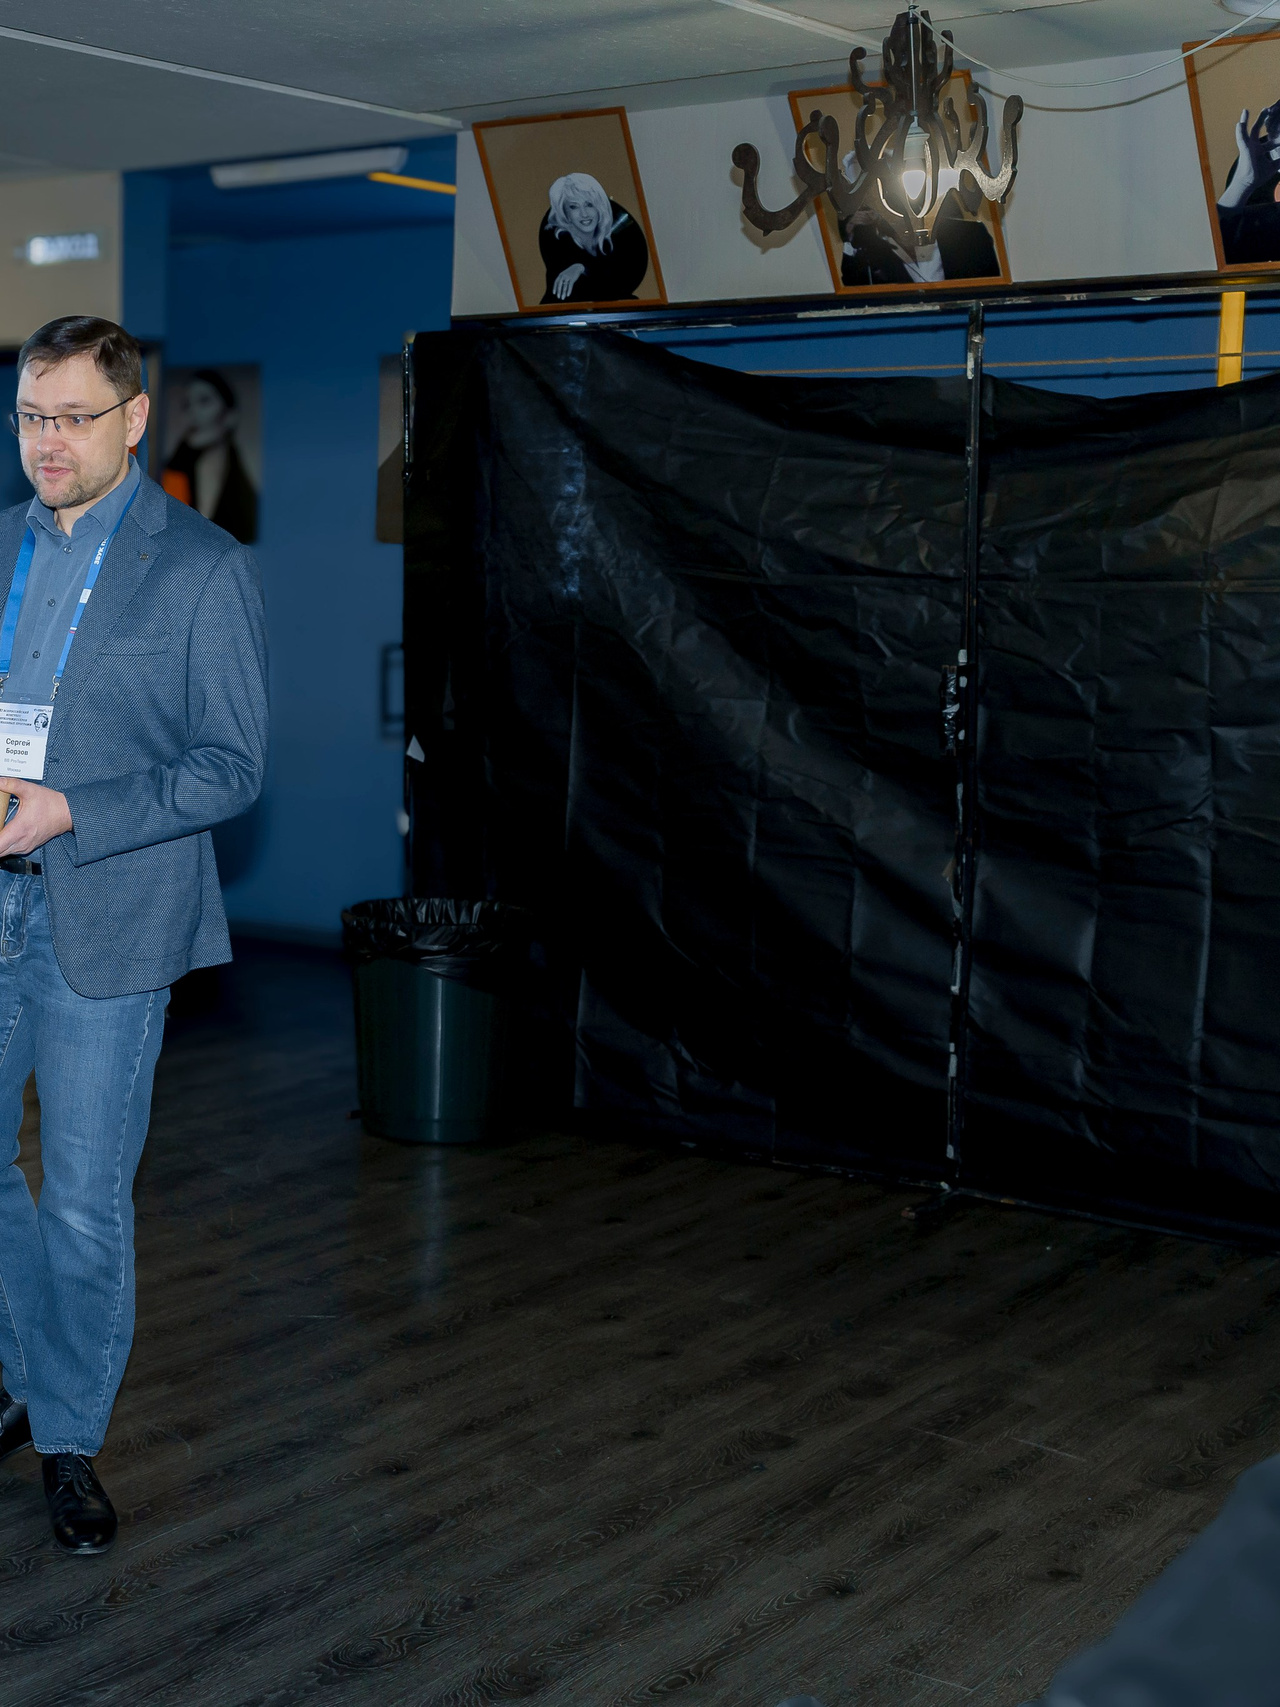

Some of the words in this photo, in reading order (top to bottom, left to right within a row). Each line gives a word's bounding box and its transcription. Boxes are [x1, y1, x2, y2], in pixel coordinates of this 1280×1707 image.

[94, 547, 105, 565] ЗВУК
[6, 738, 30, 747] Сергей
[6, 748, 28, 756] Борзов
